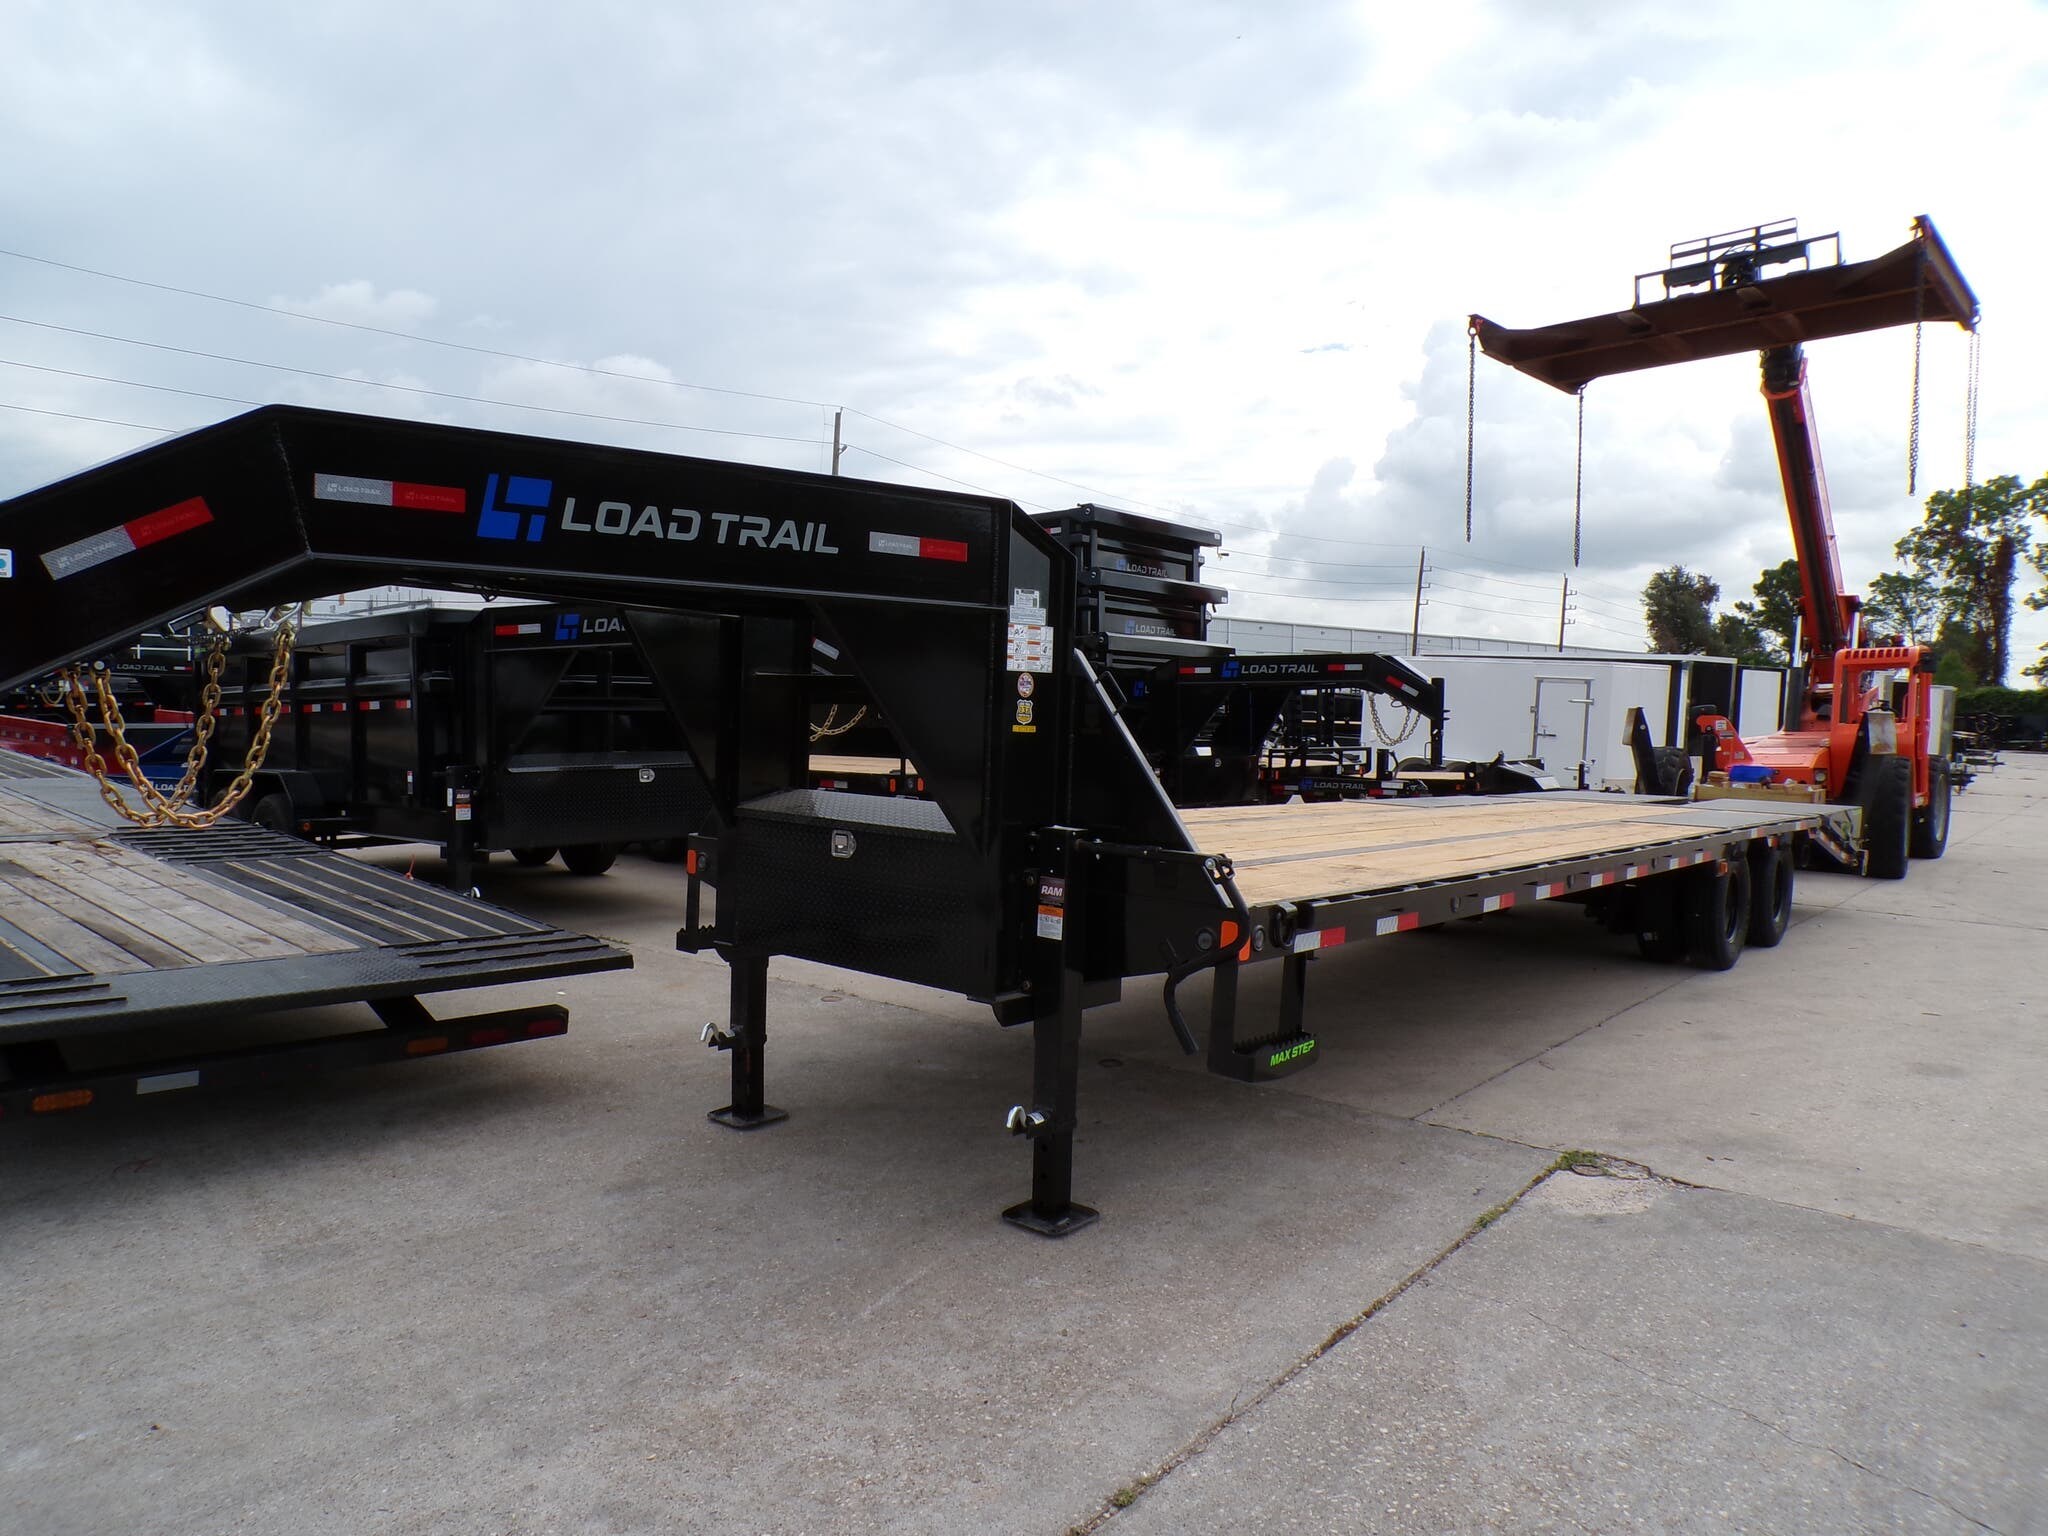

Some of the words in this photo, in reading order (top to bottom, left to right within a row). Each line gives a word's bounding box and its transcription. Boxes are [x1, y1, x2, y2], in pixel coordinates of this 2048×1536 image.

[561, 497, 701, 541] LOAD
[711, 512, 839, 554] TRAIL
[1127, 563, 1147, 574] LOAD
[1148, 567, 1168, 578] TRAIL
[583, 618, 626, 633] LOA
[1136, 624, 1155, 634] LOAD
[1156, 626, 1176, 637] TRAIL
[142, 664, 168, 672] TRAIL
[1241, 665, 1278, 674] LOAD
[1280, 664, 1319, 673] TRAIL
[1340, 782, 1366, 790] TRAIL
[1041, 885, 1063, 897] RAM
[1270, 1048, 1291, 1066] MAX
[1291, 1039, 1315, 1058] STEP
